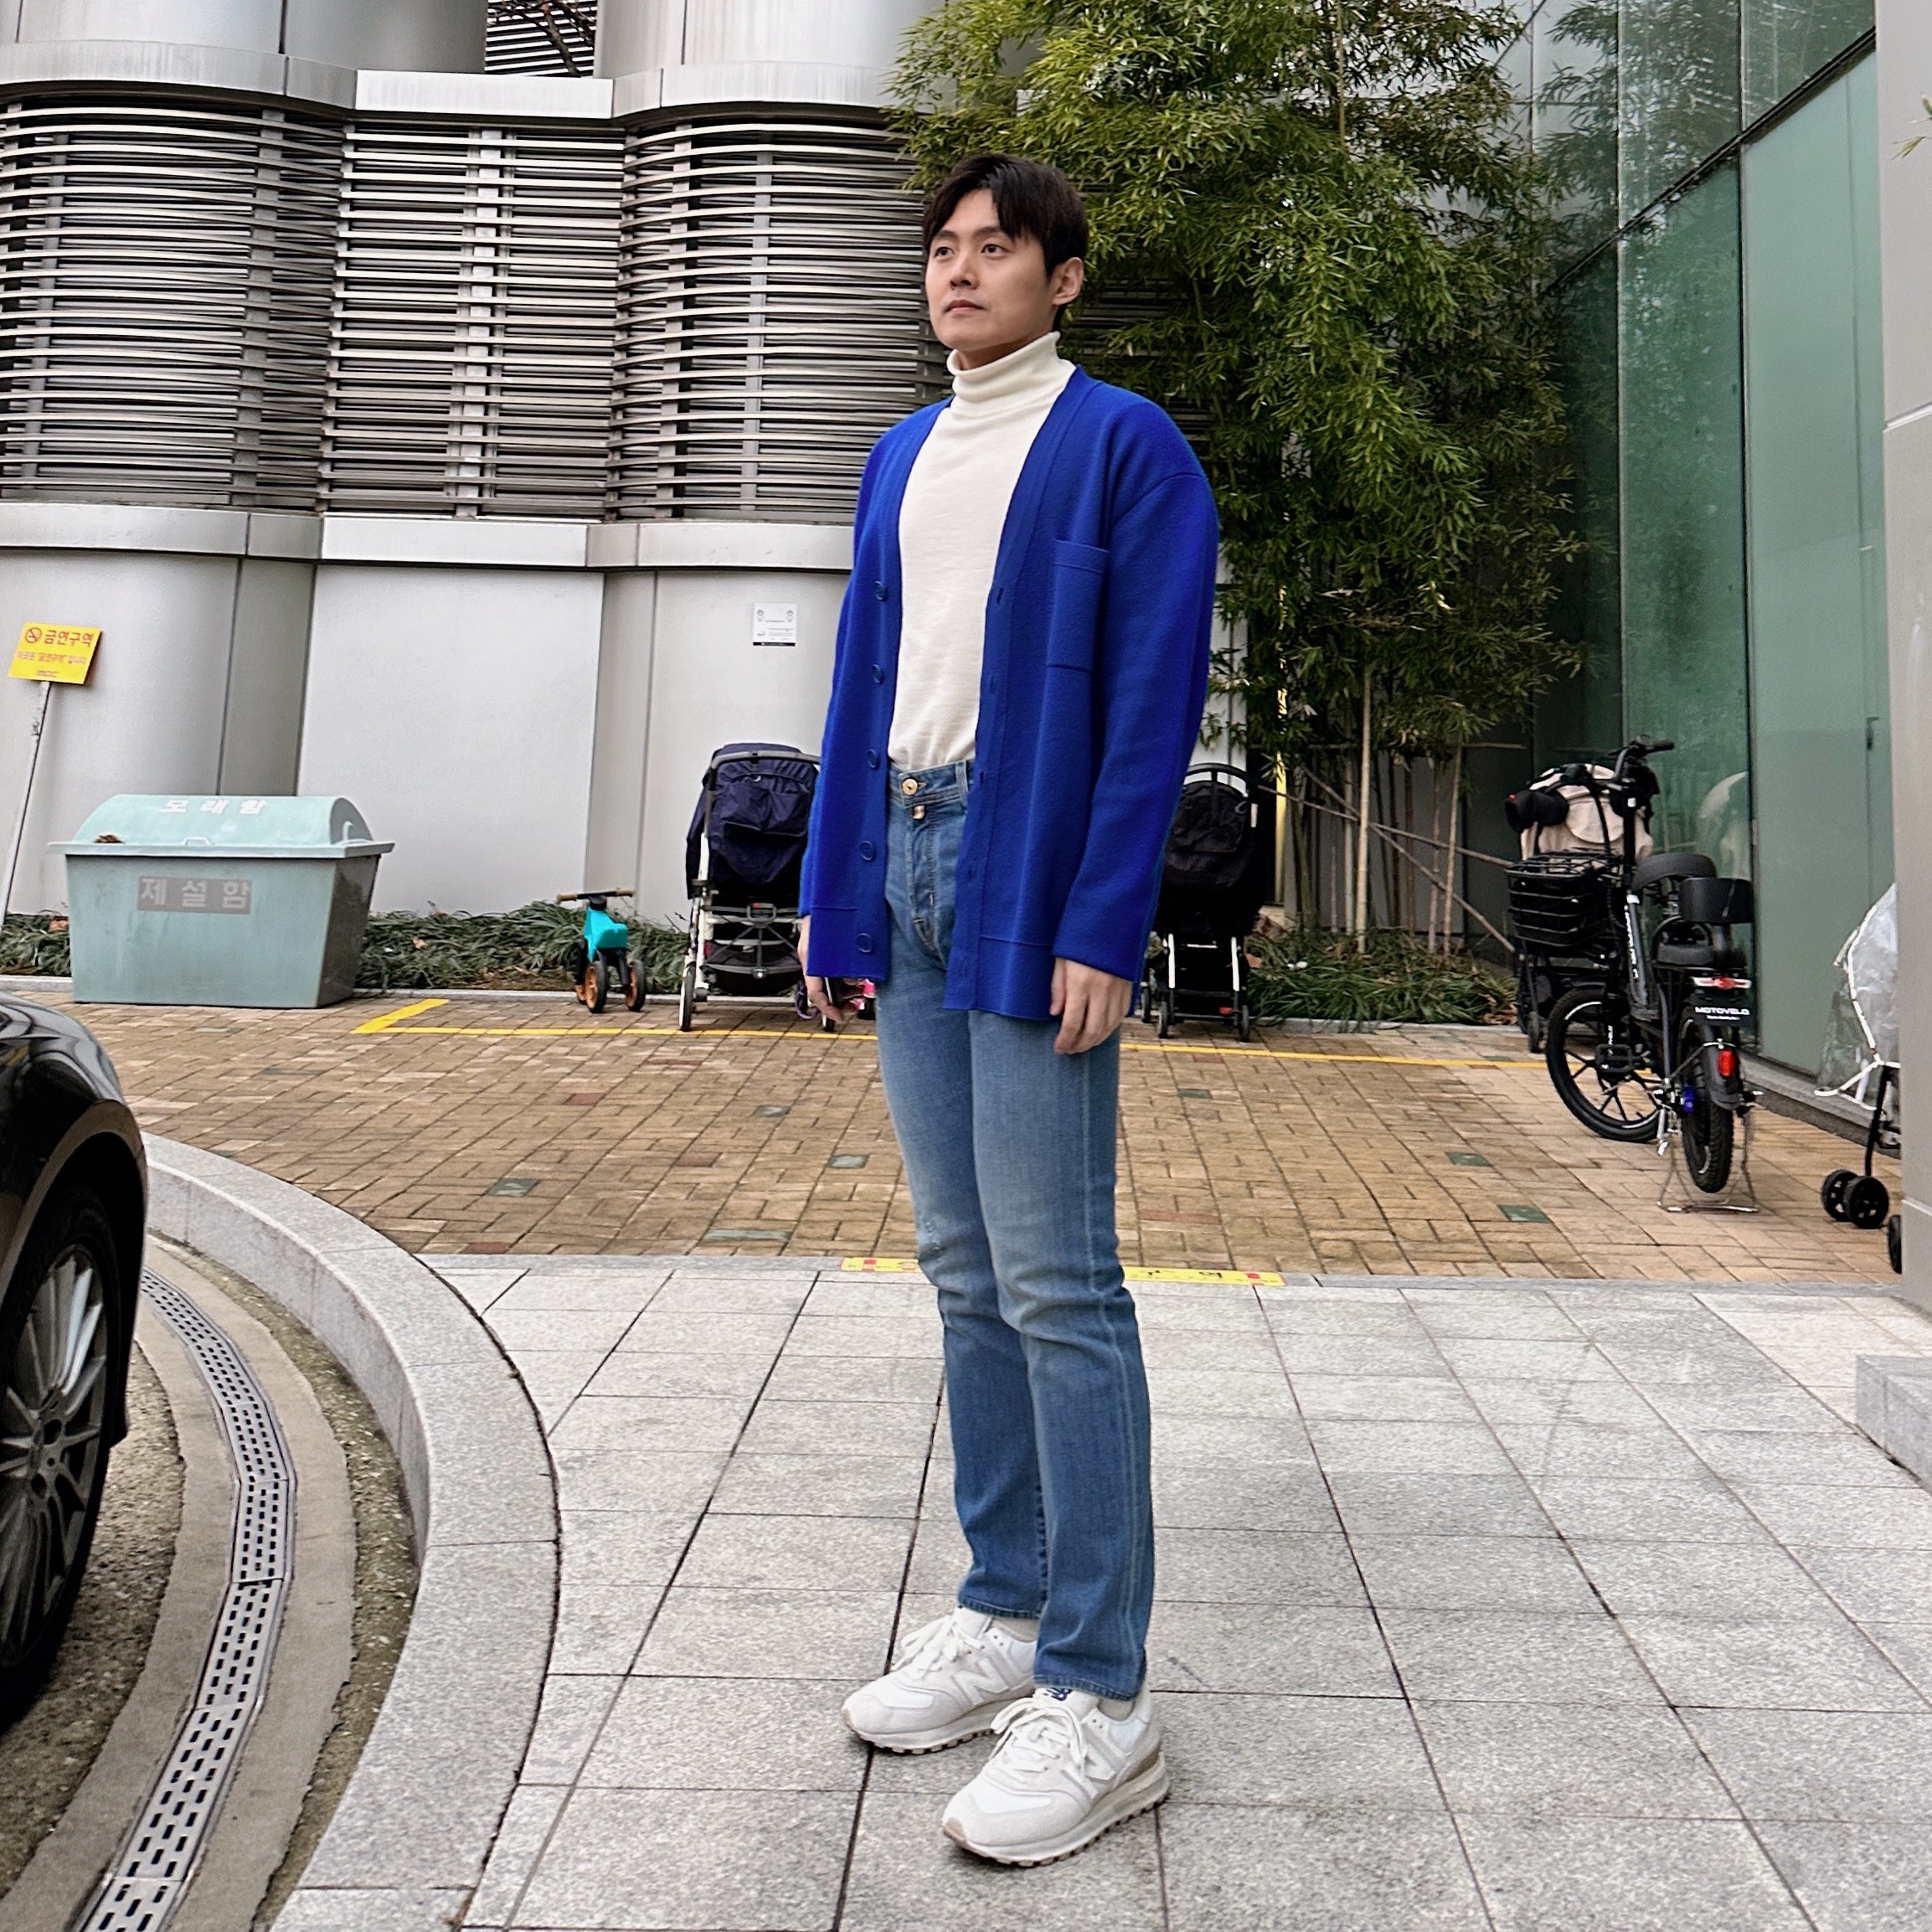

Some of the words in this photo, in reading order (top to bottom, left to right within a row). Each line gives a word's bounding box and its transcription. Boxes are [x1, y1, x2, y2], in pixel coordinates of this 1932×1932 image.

[44, 629, 95, 648] 금연구역
[159, 799, 268, 815] 모래함
[140, 878, 250, 909] 제설함
